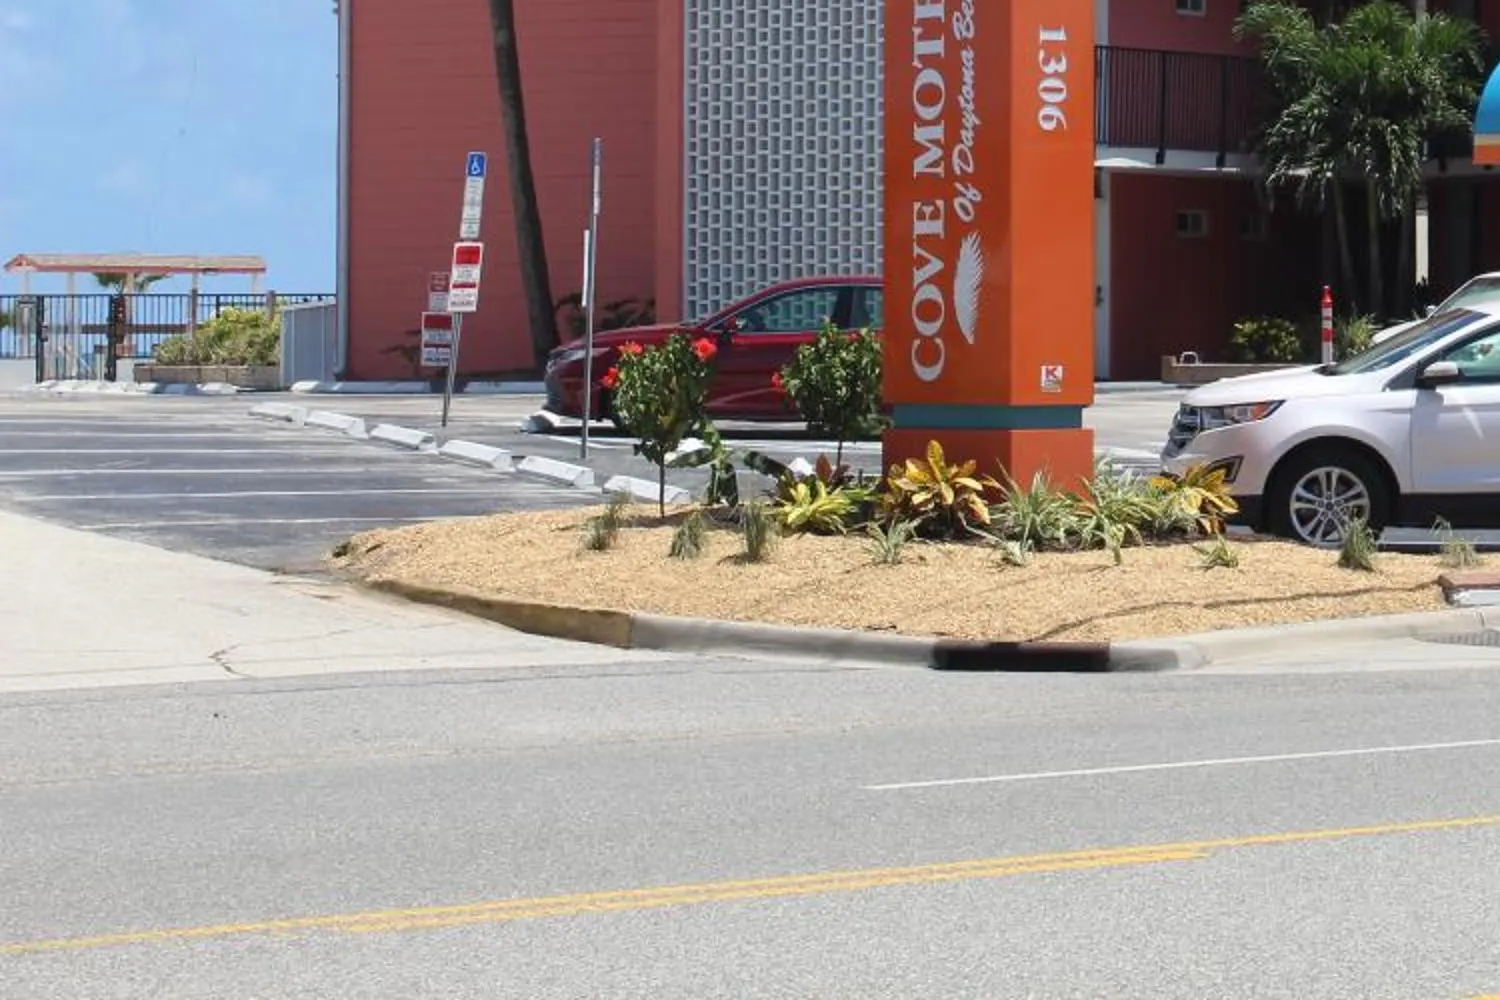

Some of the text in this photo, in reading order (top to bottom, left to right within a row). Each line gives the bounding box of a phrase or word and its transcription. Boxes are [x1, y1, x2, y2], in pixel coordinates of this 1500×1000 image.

[951, 47, 984, 175] Daytona
[1037, 24, 1069, 131] 1306
[953, 182, 983, 223] Of
[911, 200, 945, 382] COVE
